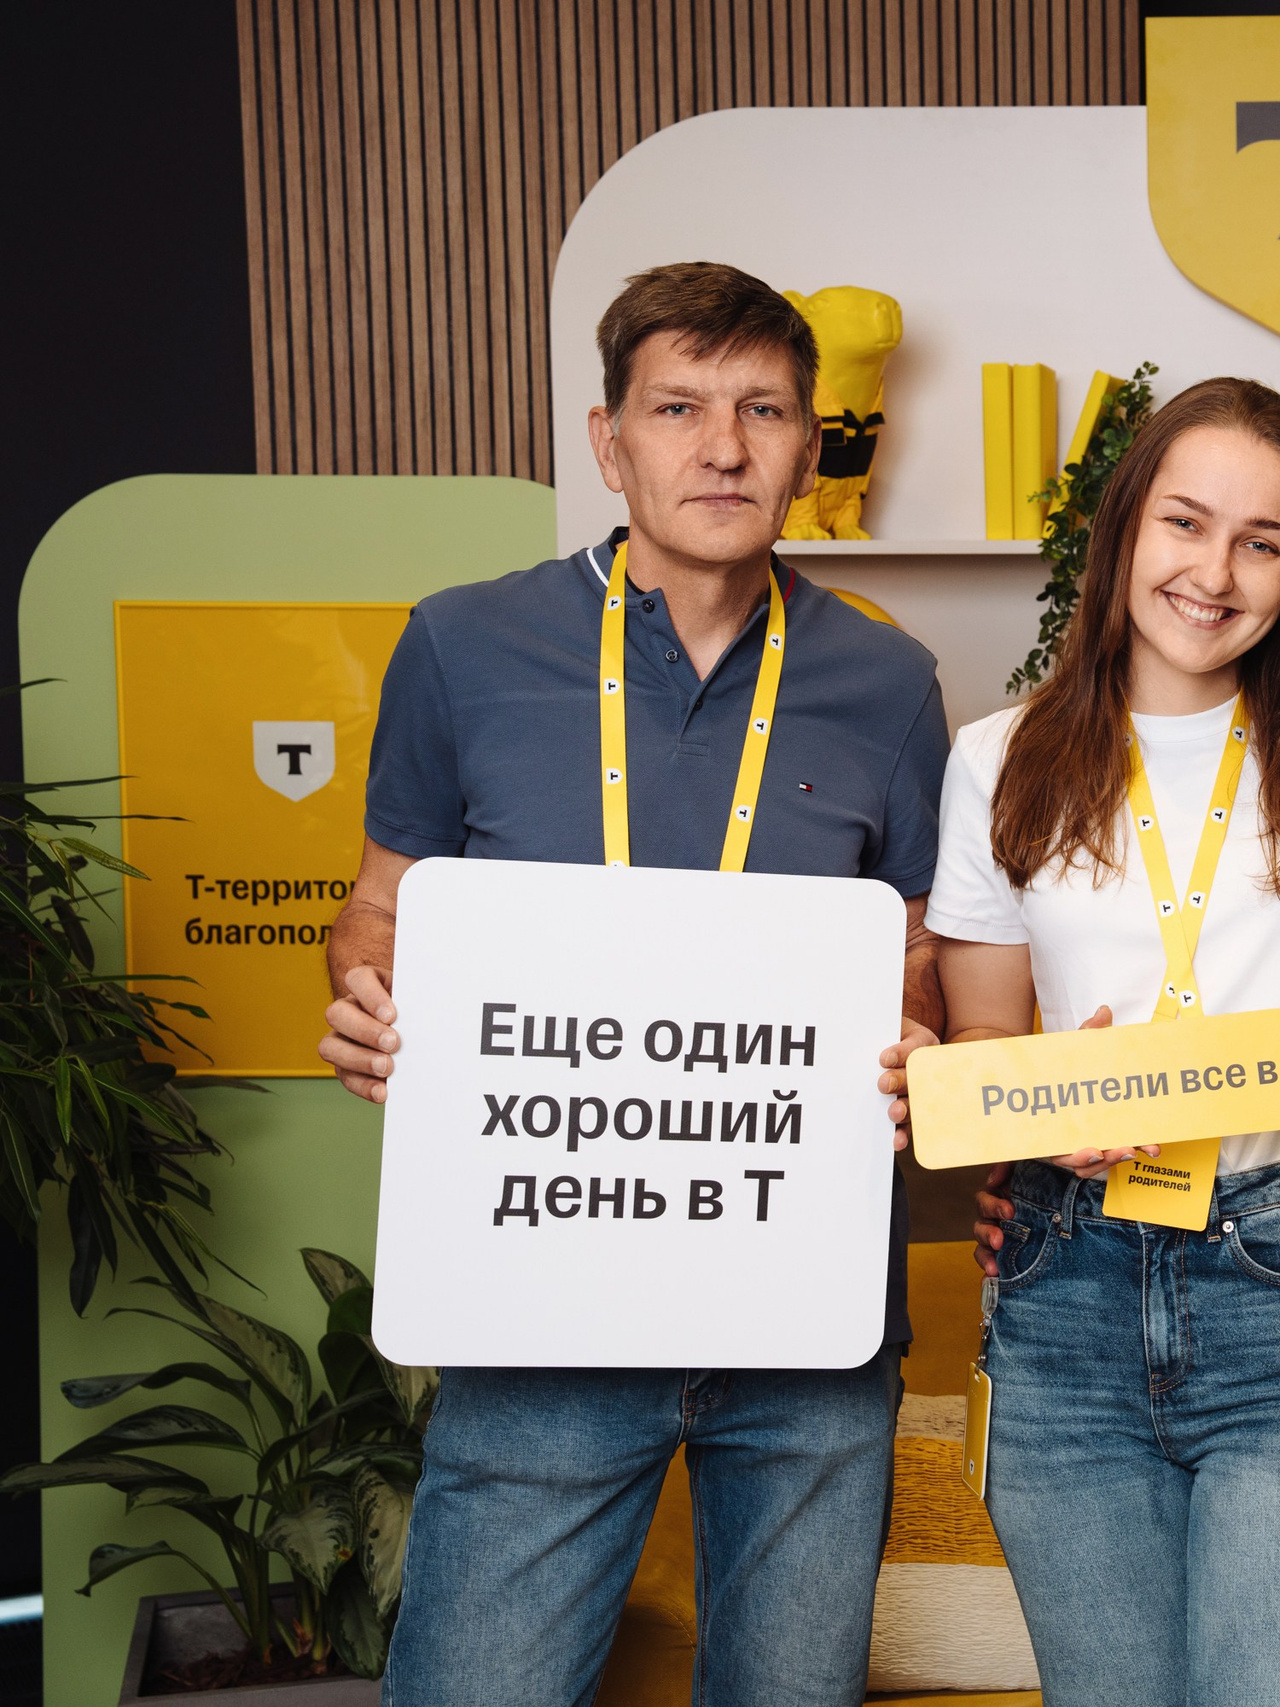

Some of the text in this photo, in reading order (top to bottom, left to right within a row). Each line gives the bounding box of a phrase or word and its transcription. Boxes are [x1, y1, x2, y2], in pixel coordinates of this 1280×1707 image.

[276, 743, 312, 776] Т
[480, 1002, 816, 1074] Еще один
[981, 1071, 1170, 1117] Родители
[1180, 1063, 1247, 1095] все
[1256, 1059, 1279, 1086] в
[480, 1089, 803, 1153] хороший
[492, 1169, 785, 1227] день в Т
[1128, 1173, 1191, 1192] родителей
[1134, 1161, 1191, 1180] Т глазами
